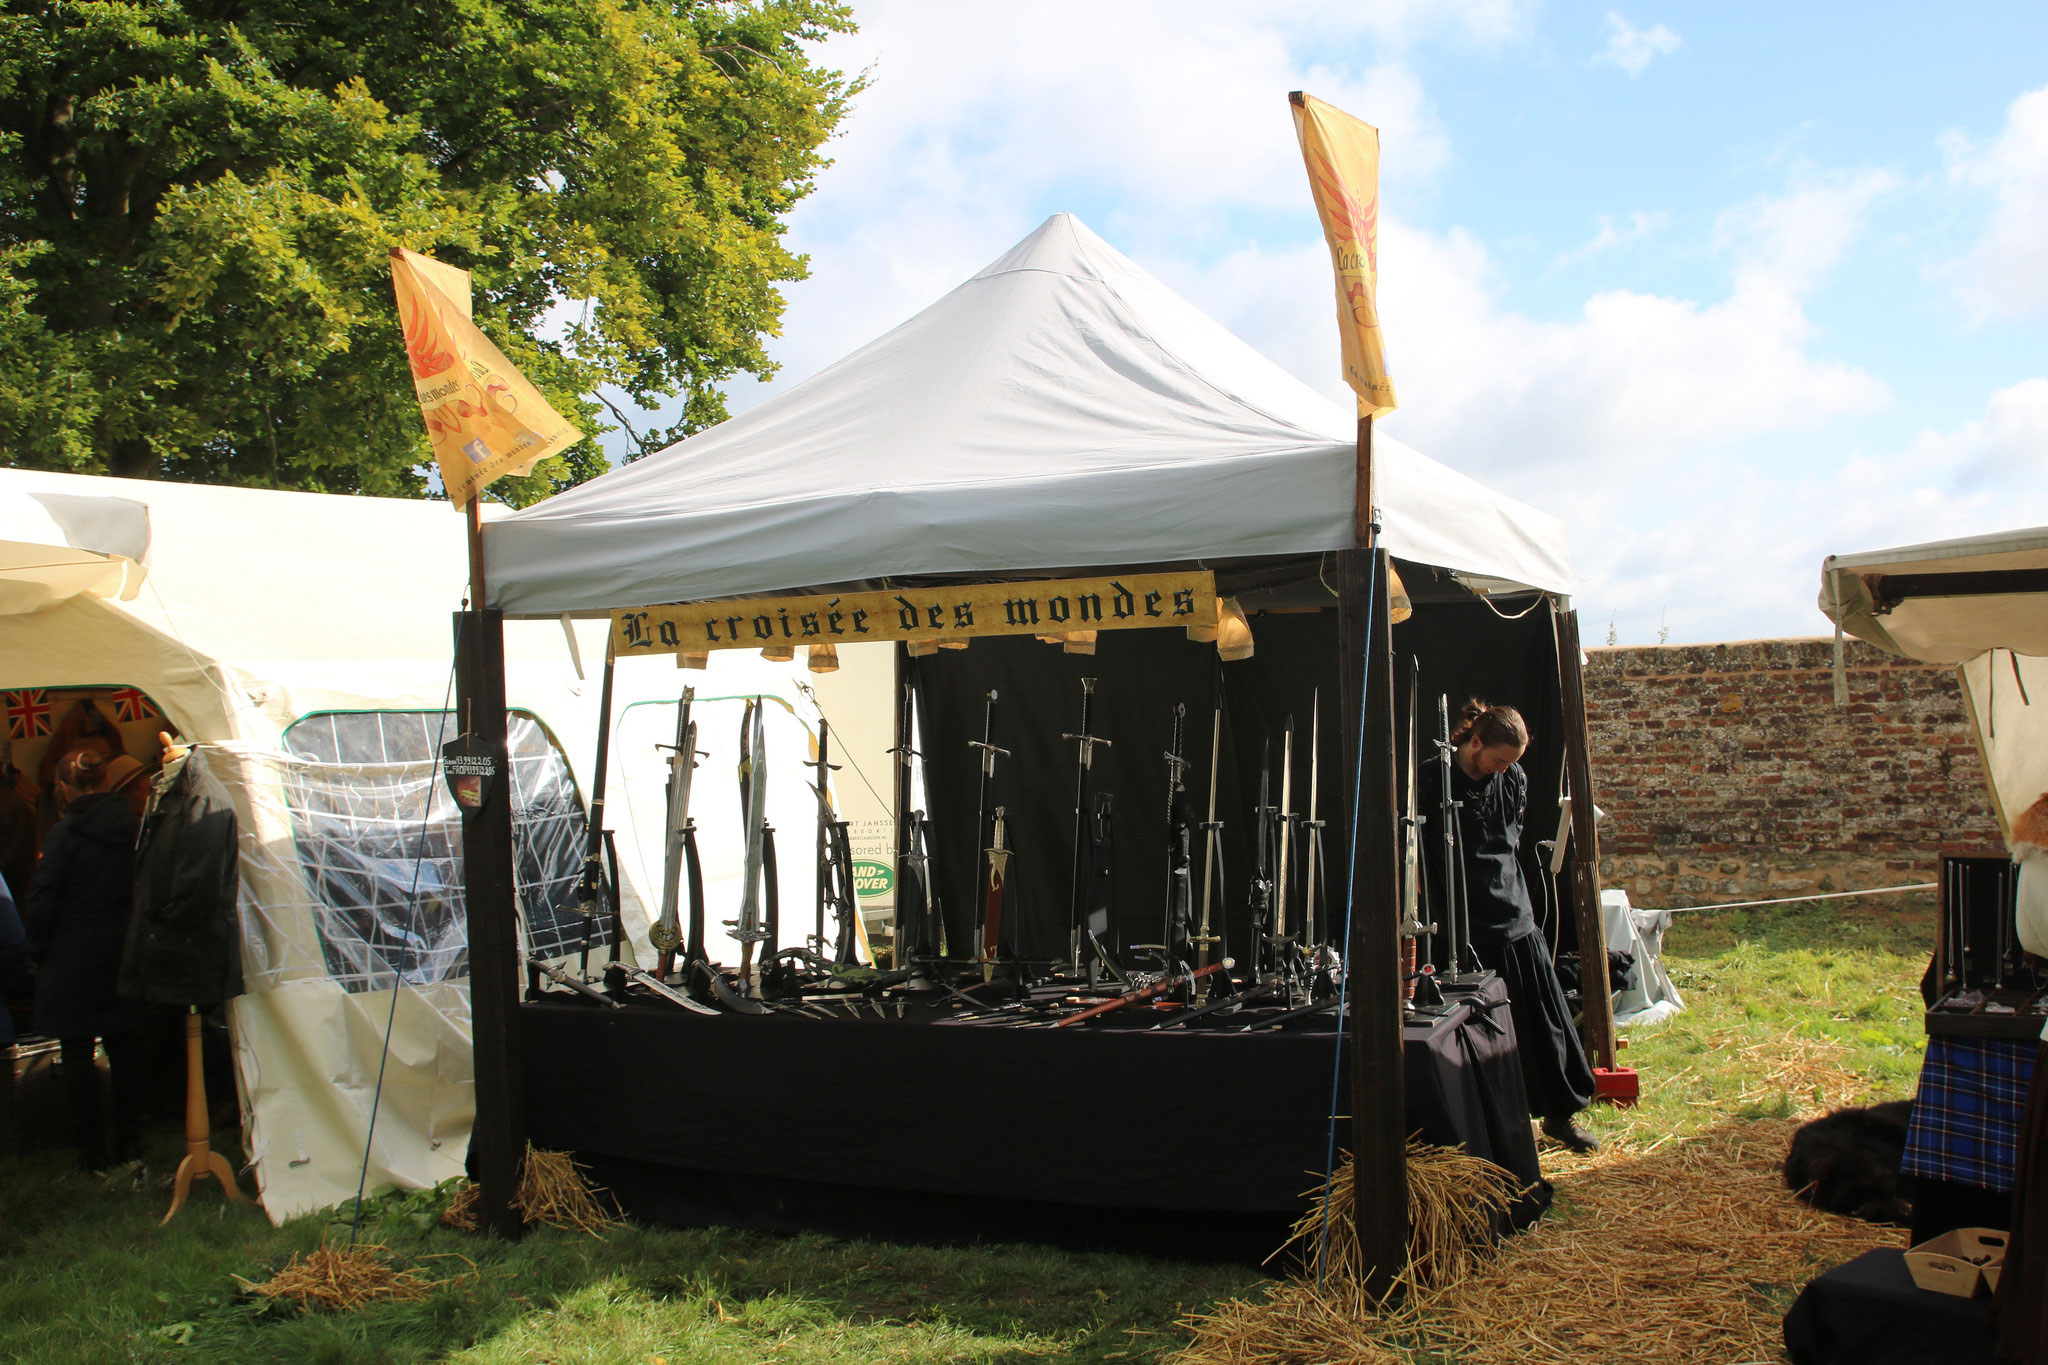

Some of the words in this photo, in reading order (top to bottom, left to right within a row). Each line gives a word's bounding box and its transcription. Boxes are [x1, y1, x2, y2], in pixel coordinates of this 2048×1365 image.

[621, 611, 681, 648] La
[705, 597, 870, 641] croisée
[894, 595, 974, 630] des
[1003, 580, 1194, 626] mondes
[862, 819, 894, 827] JANSSE
[855, 878, 889, 889] OVER
